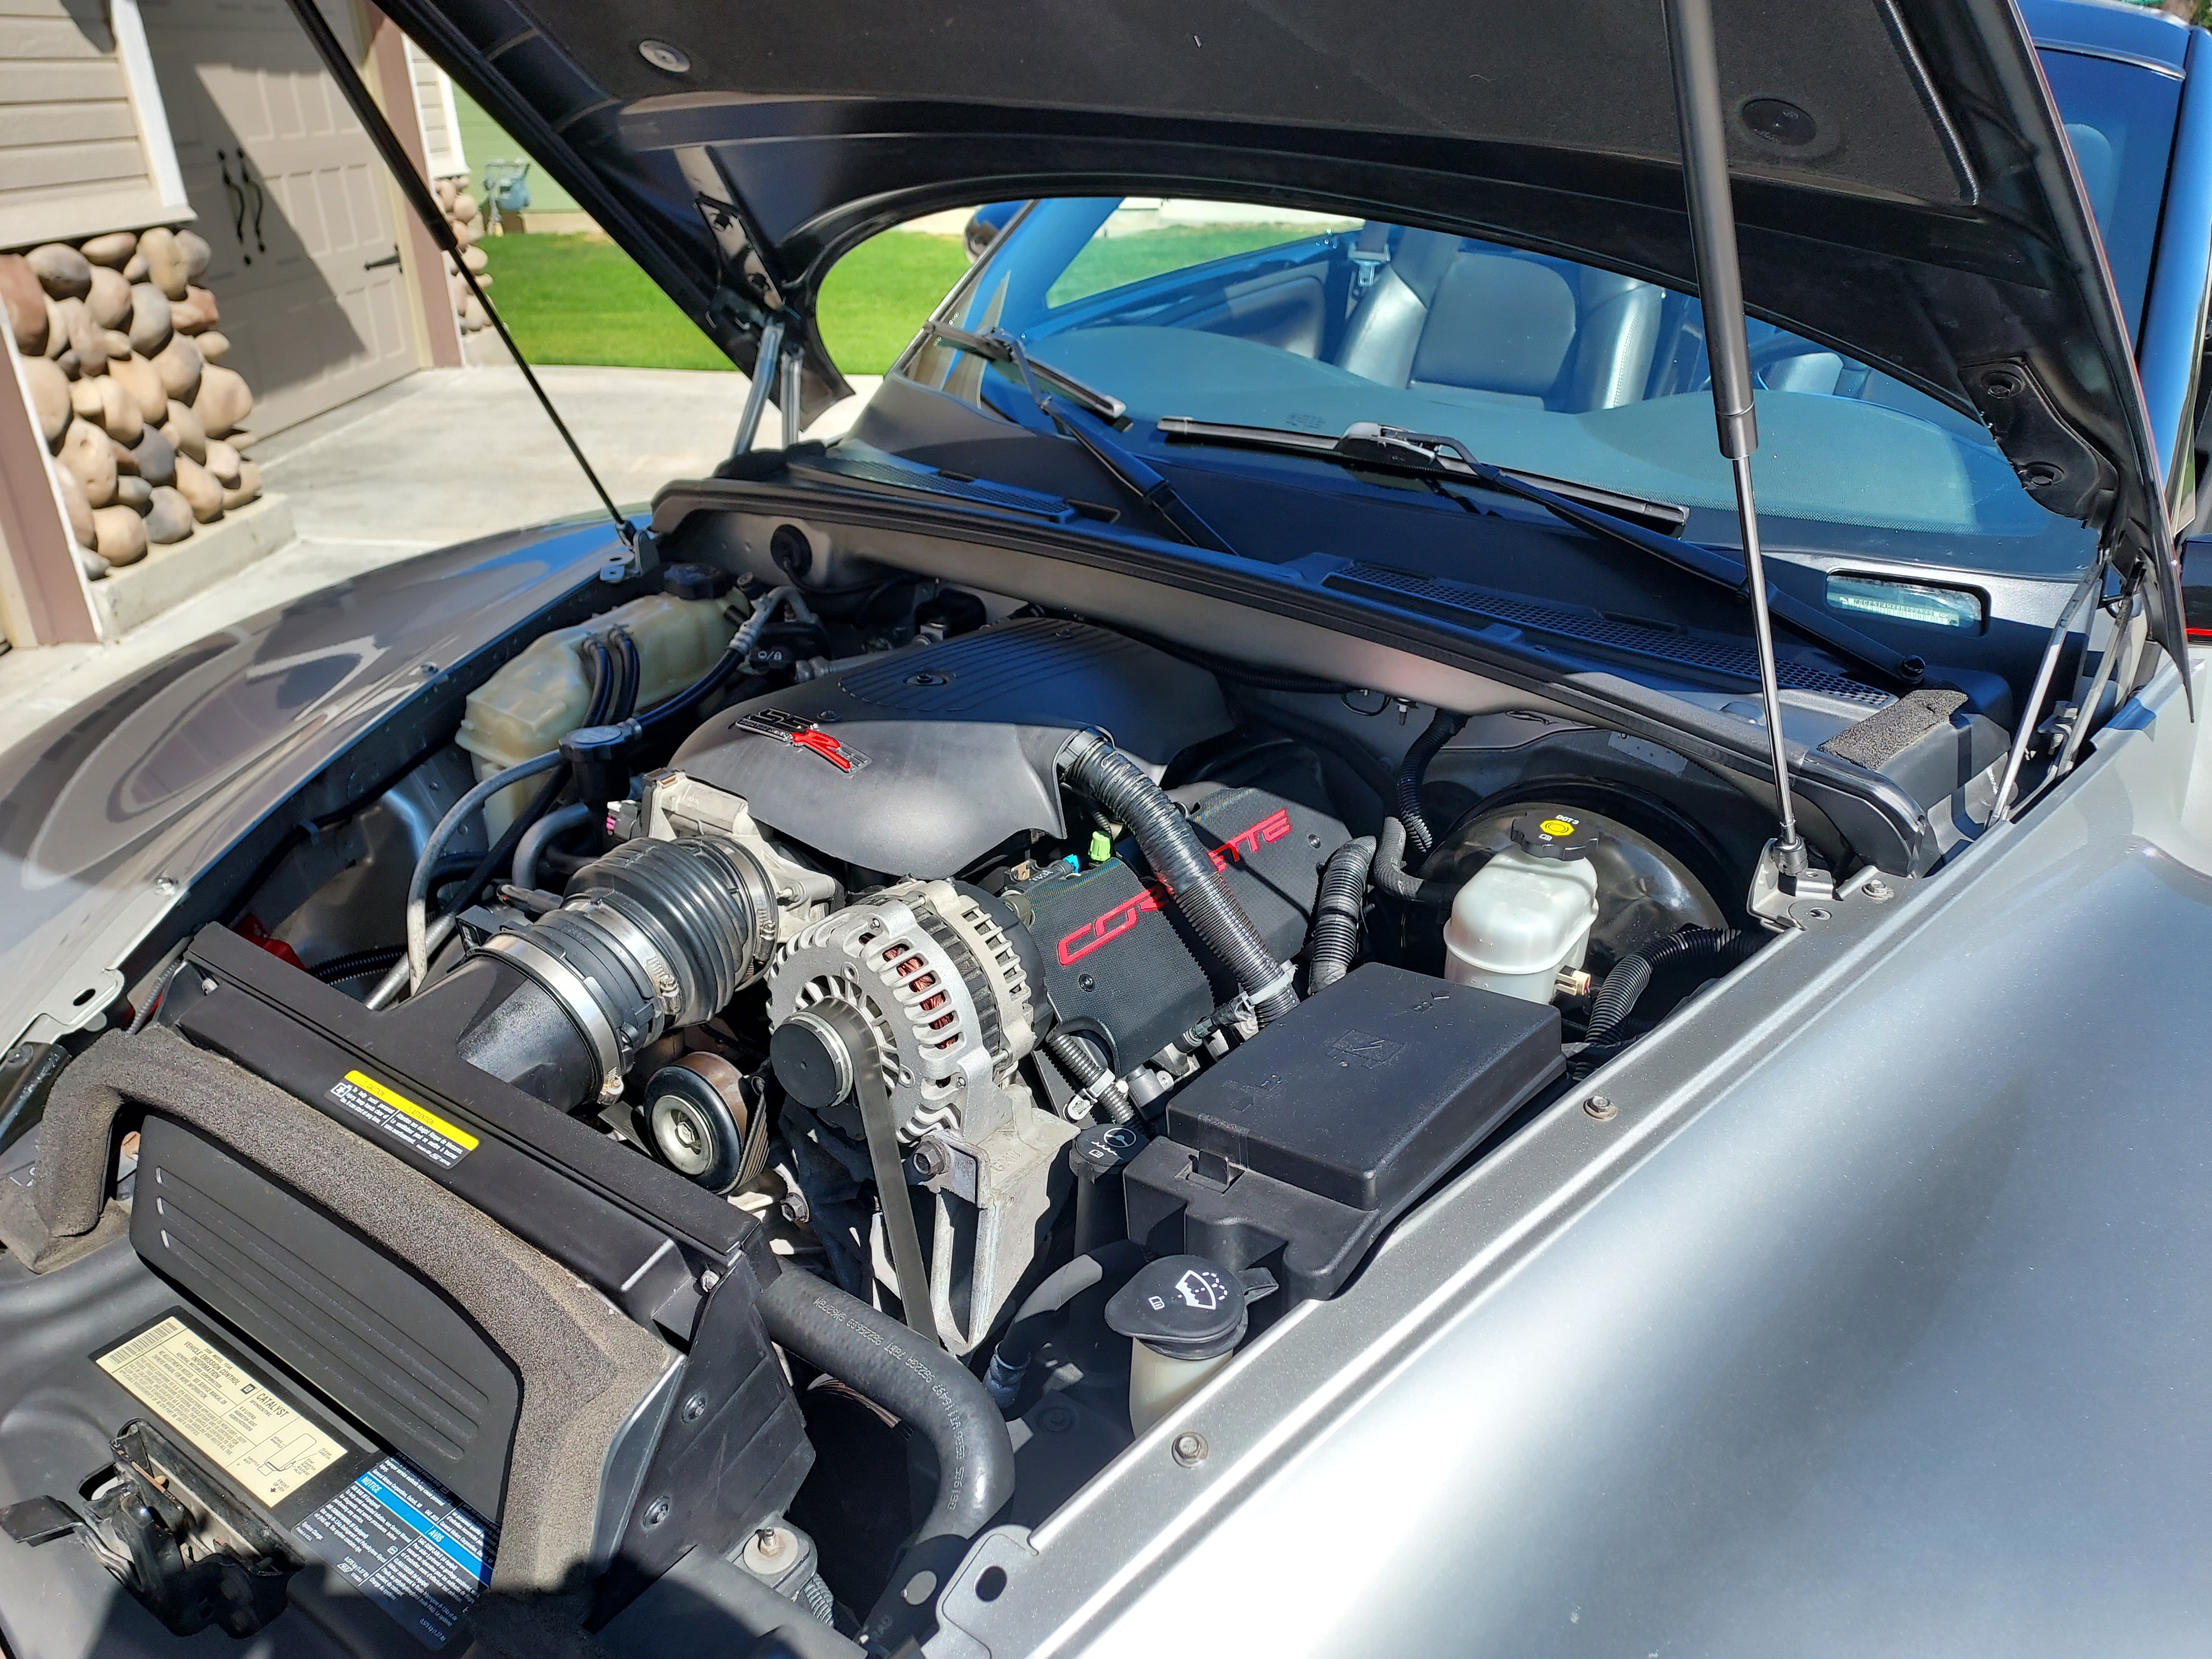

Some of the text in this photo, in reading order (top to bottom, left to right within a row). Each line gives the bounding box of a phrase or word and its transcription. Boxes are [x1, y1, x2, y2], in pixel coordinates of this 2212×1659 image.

[366, 1083, 386, 1096] CAUTION
[409, 1109, 435, 1125] ATTENTION
[175, 1352, 223, 1389] GENERAL MOTORS CORPORATION
[182, 1340, 204, 1356] VEHICLE
[199, 1353, 222, 1371] EMISSION
[218, 1368, 242, 1386] CONTROL
[190, 1355, 222, 1379] INFORMATION
[161, 1363, 177, 1374] MANUAL
[178, 1376, 190, 1385] MORE
[161, 1353, 184, 1370] ADJUSTMENTS
[197, 1381, 212, 1393] SERVICE
[208, 1390, 223, 1402] MANUAL
[243, 1410, 257, 1420] LITERS
[255, 1392, 290, 1418] CATALYST
[276, 1478, 290, 1489] FRONT
[359, 1475, 383, 1494] NOTICE
[371, 1468, 385, 1479] General
[380, 1475, 394, 1486] Motors
[383, 1459, 399, 1471] Improper
[395, 1468, 408, 1478] service
[404, 1475, 419, 1487] methods
[421, 1489, 433, 1498] cause
[429, 1494, 445, 1507] personal
[331, 1498, 350, 1512] performing
[300, 1521, 314, 1532] System
[330, 1506, 353, 1526] CONDITIONING
[342, 1496, 359, 1510] diagnostic
[359, 1511, 374, 1522] service
[369, 1518, 388, 1534] procedures
[385, 1530, 398, 1541] before
[353, 1496, 364, 1505] avoid
[389, 1524, 403, 1535] Service
[399, 1532, 413, 1543] Manual
[324, 1511, 334, 1520] only
[338, 1524, 357, 1539] Refrigerant
[353, 1536, 363, 1544] and
[374, 1553, 387, 1564] Glycol
[427, 1528, 445, 1543] AVIS
